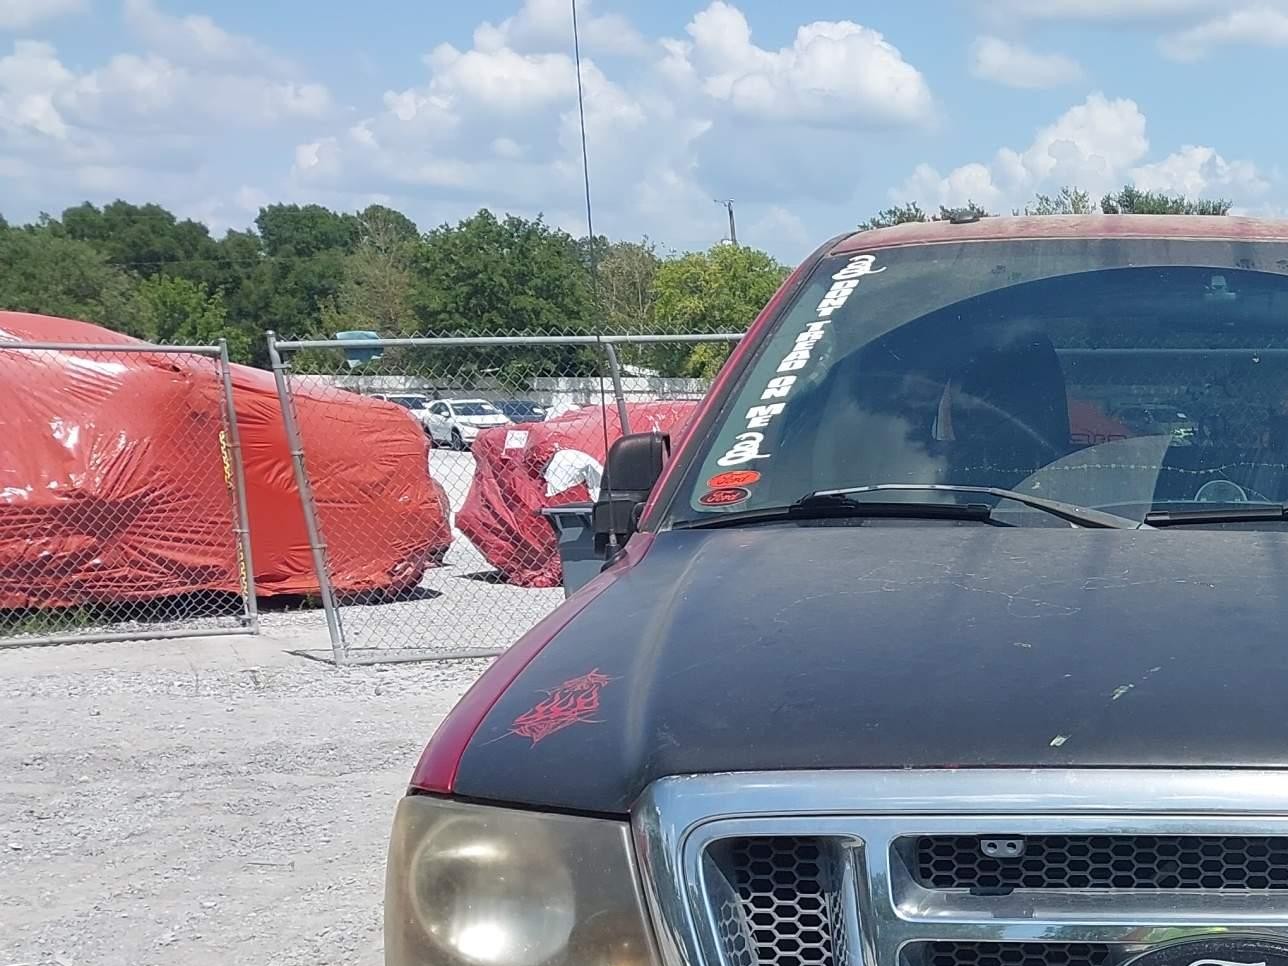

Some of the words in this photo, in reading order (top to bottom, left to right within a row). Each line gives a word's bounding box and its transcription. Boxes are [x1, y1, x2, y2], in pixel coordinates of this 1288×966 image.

[816, 279, 860, 318] DONT
[776, 319, 832, 373] TREAD
[760, 375, 798, 400] ON
[745, 402, 787, 429] ME
[706, 490, 741, 503] Ford
